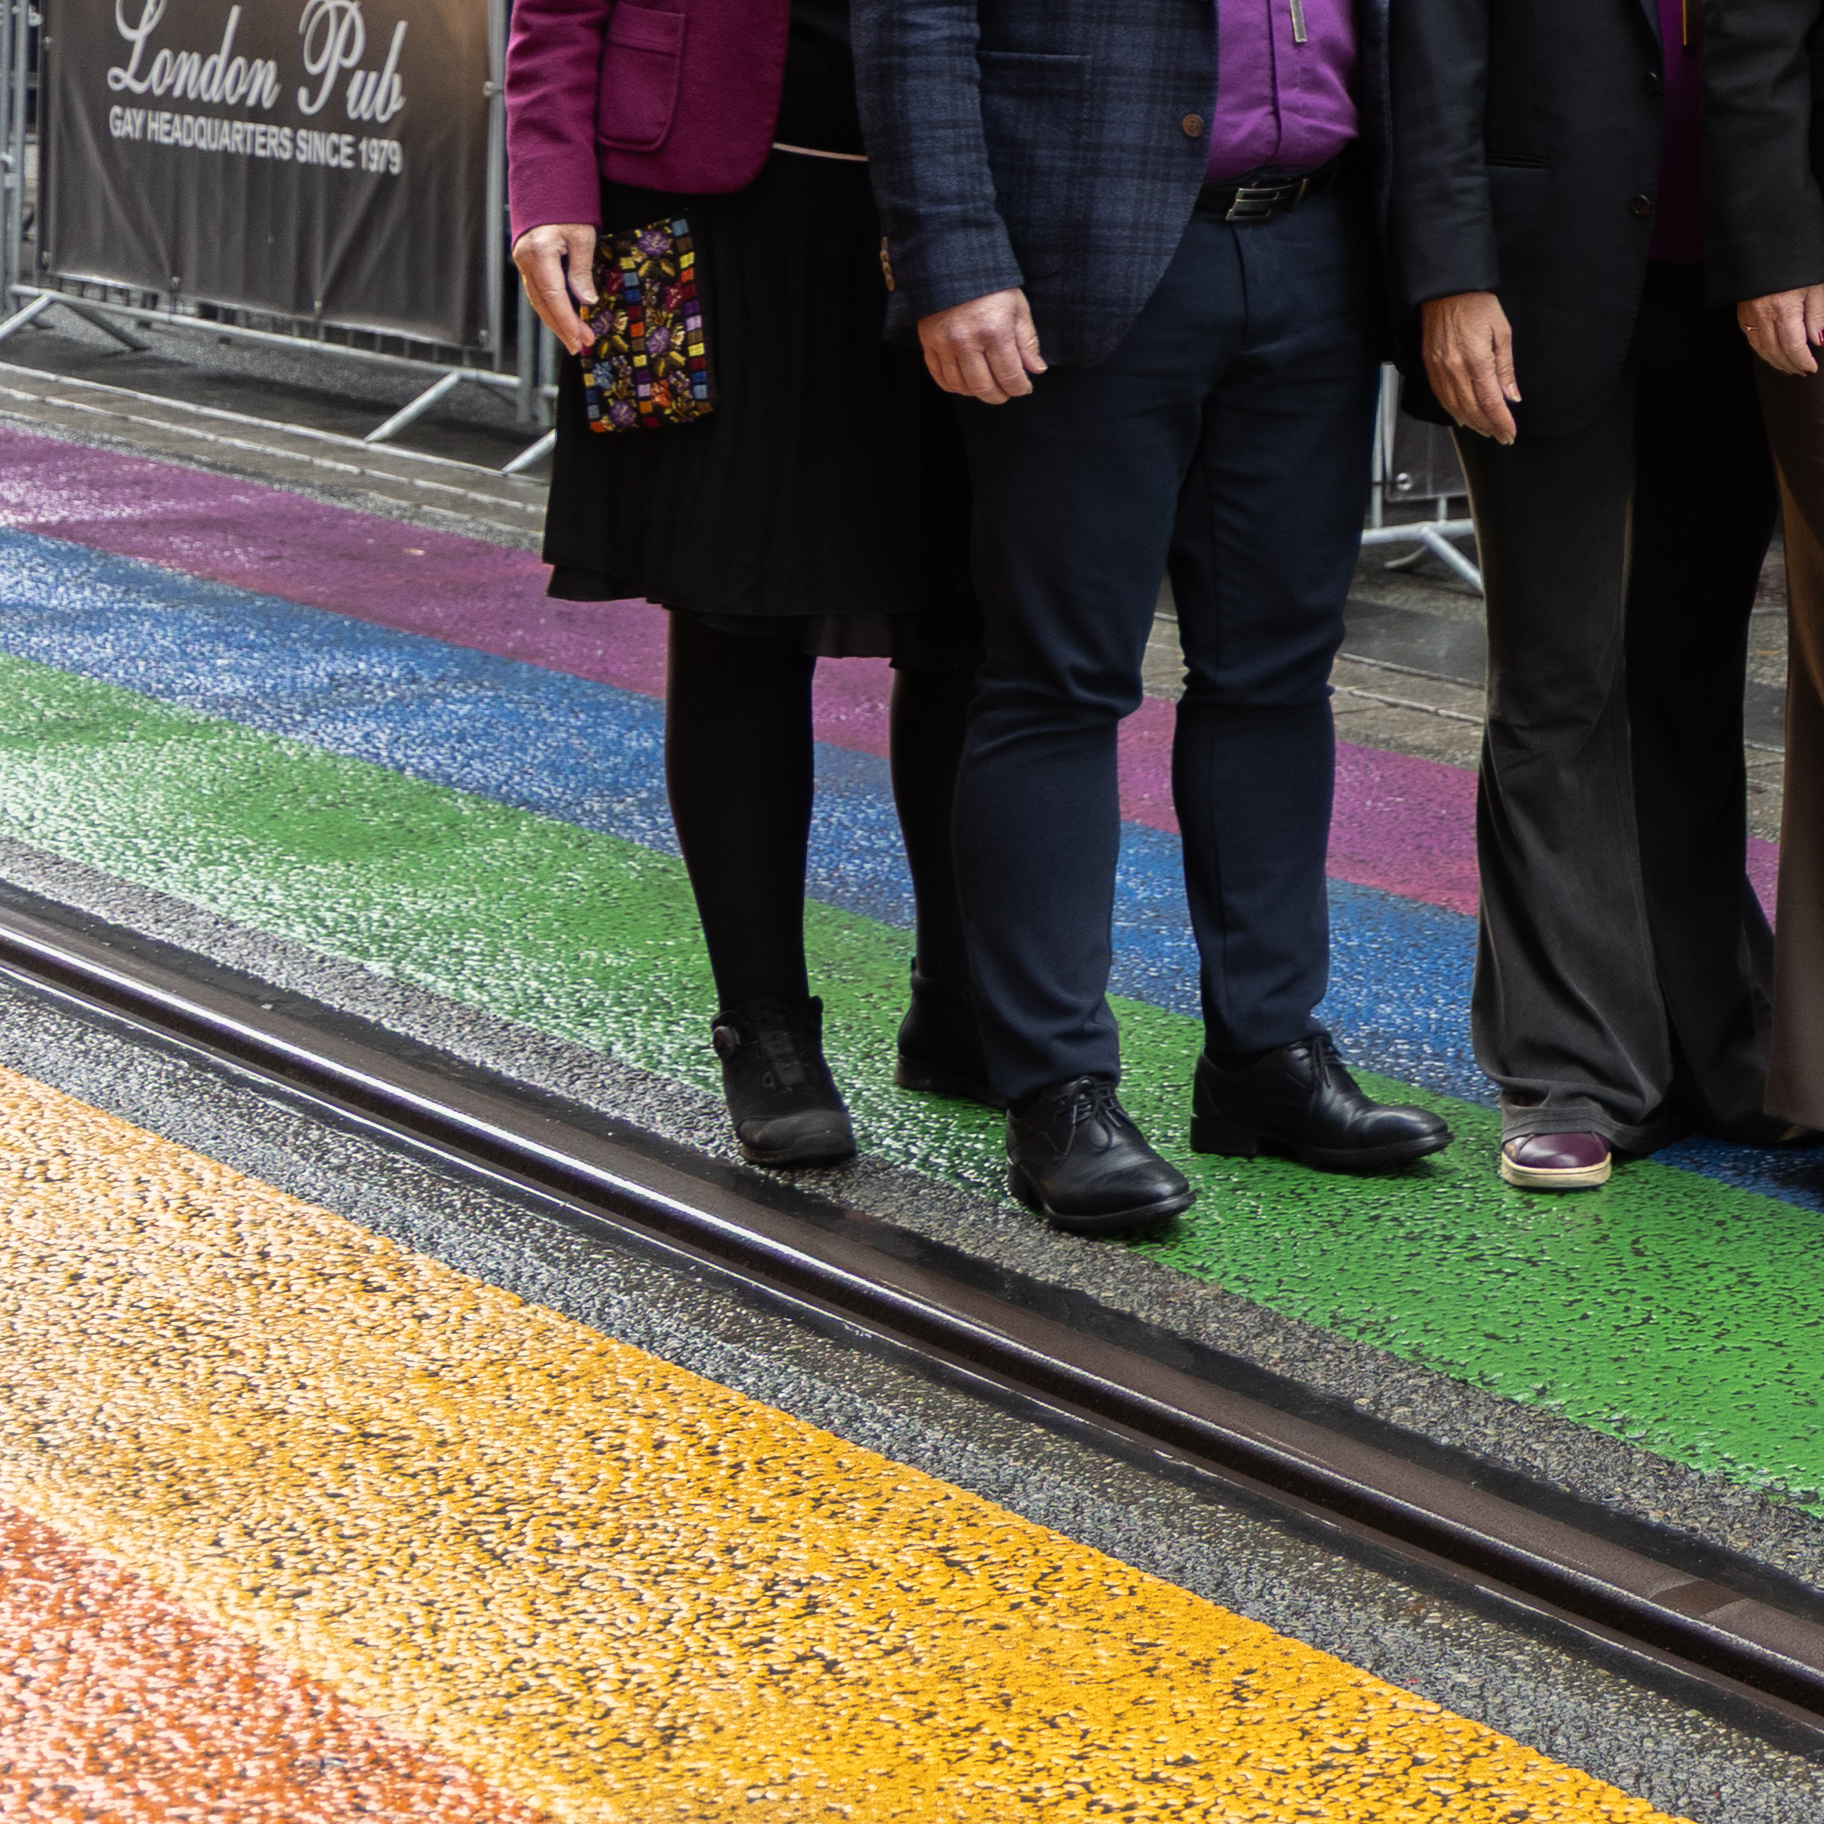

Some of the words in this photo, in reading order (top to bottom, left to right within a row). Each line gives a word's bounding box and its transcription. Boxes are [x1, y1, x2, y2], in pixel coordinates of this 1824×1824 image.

[109, 104, 146, 140] GAY
[147, 110, 293, 160] HEADQUARTERS
[295, 128, 355, 169] SINCE
[358, 138, 402, 174] 1979
